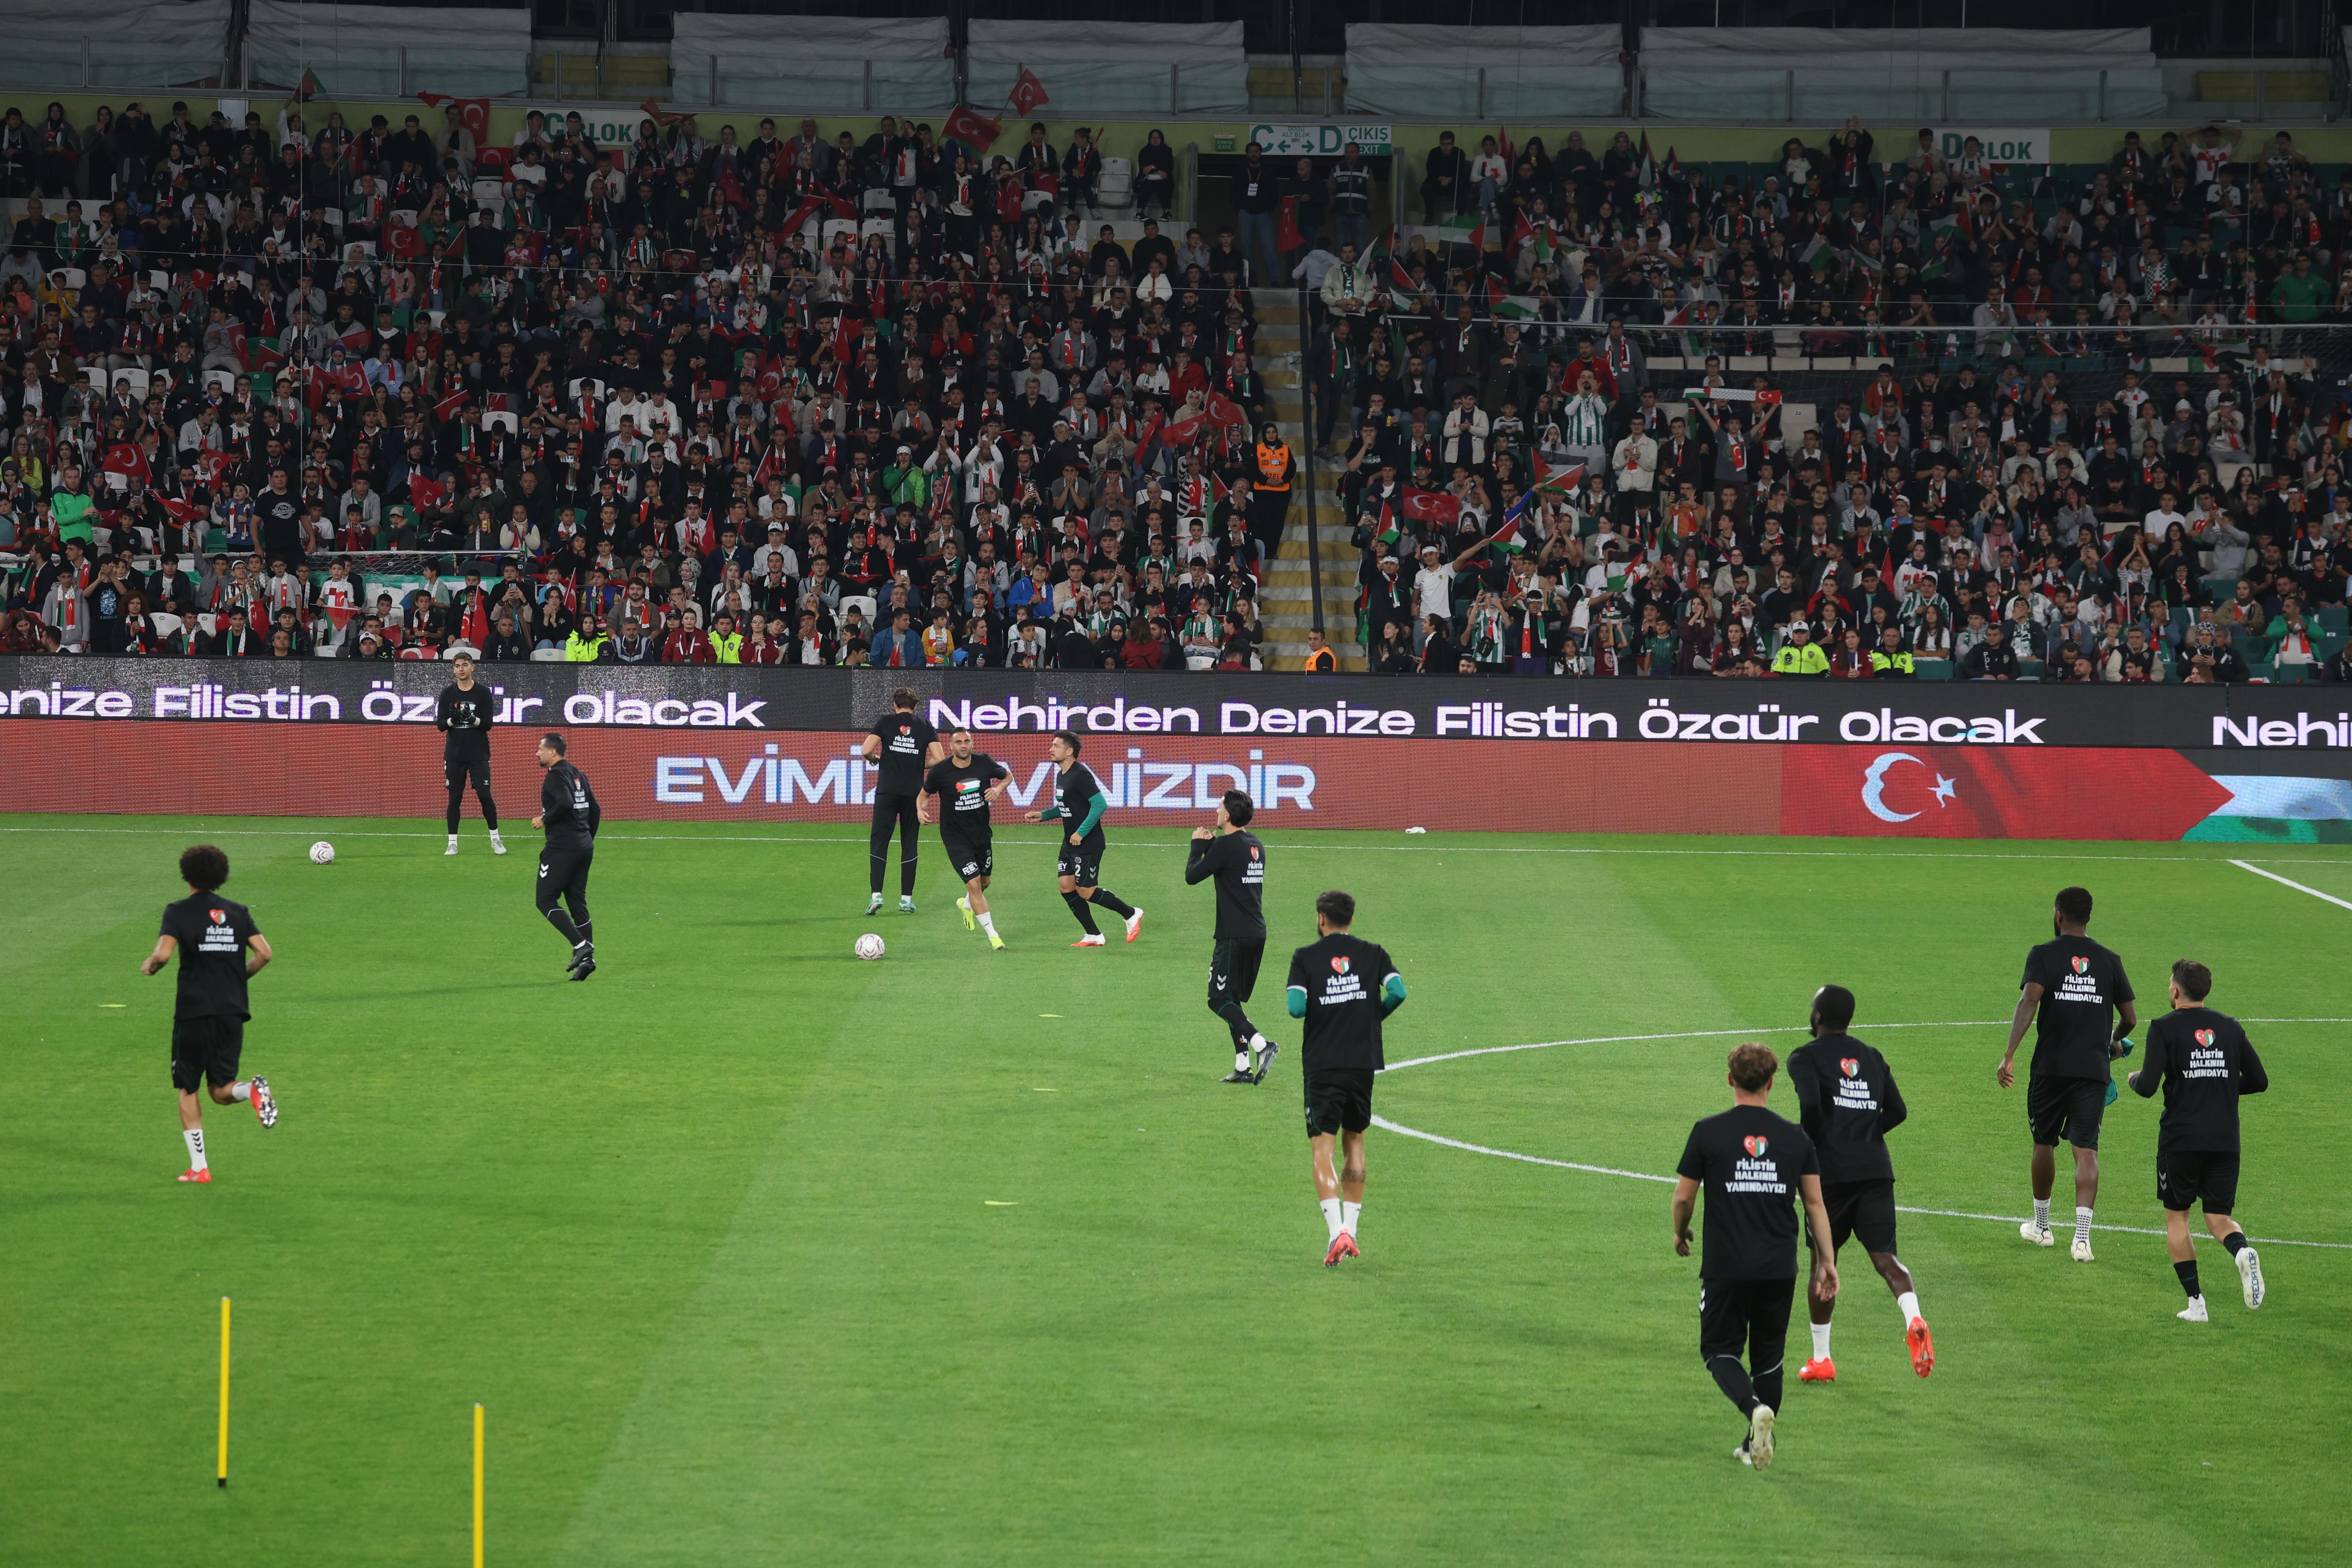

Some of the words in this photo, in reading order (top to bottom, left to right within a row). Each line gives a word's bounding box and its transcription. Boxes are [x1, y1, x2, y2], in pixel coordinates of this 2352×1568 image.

[1250, 125, 1274, 153] C
[1319, 126, 1343, 153] D
[1348, 127, 1388, 142] ÇIKIŞ
[1943, 134, 1963, 159] D
[0, 682, 133, 717] nize
[155, 684, 339, 719] Filistin
[361, 680, 543, 724] Özür
[929, 696, 1199, 732] Nehirden
[1221, 700, 1416, 735] Denize
[1436, 702, 1618, 738] Filistin
[1839, 708, 2047, 744] Olacak
[2213, 712, 2352, 747] Nehi
[962, 861, 978, 875] REY
[985, 856, 991, 868] 9
[1075, 864, 1081, 877] 2
[1327, 973, 1359, 986] FİLİSTİN
[2064, 973, 2095, 985] FİLİSTİN
[1325, 982, 1360, 995] HALKININ
[2062, 983, 2096, 994] HALKININ
[2054, 991, 2103, 1004] YANINDAYIZ!
[2190, 1048, 2223, 1059] FİLİSTİN
[2189, 1059, 2225, 1069] HALKININ
[1838, 1077, 1868, 1090] FİLİSTİN
[1840, 1087, 1870, 1099] HALKININ
[1832, 1095, 1877, 1110] YANINDAYIZ!
[1736, 1157, 1776, 1172] FİLİSTİN
[1734, 1170, 1777, 1182] HALKININ
[1725, 1181, 1787, 1194] YANINDAYIZ!
[2249, 1251, 2260, 1306] PREDATOR
